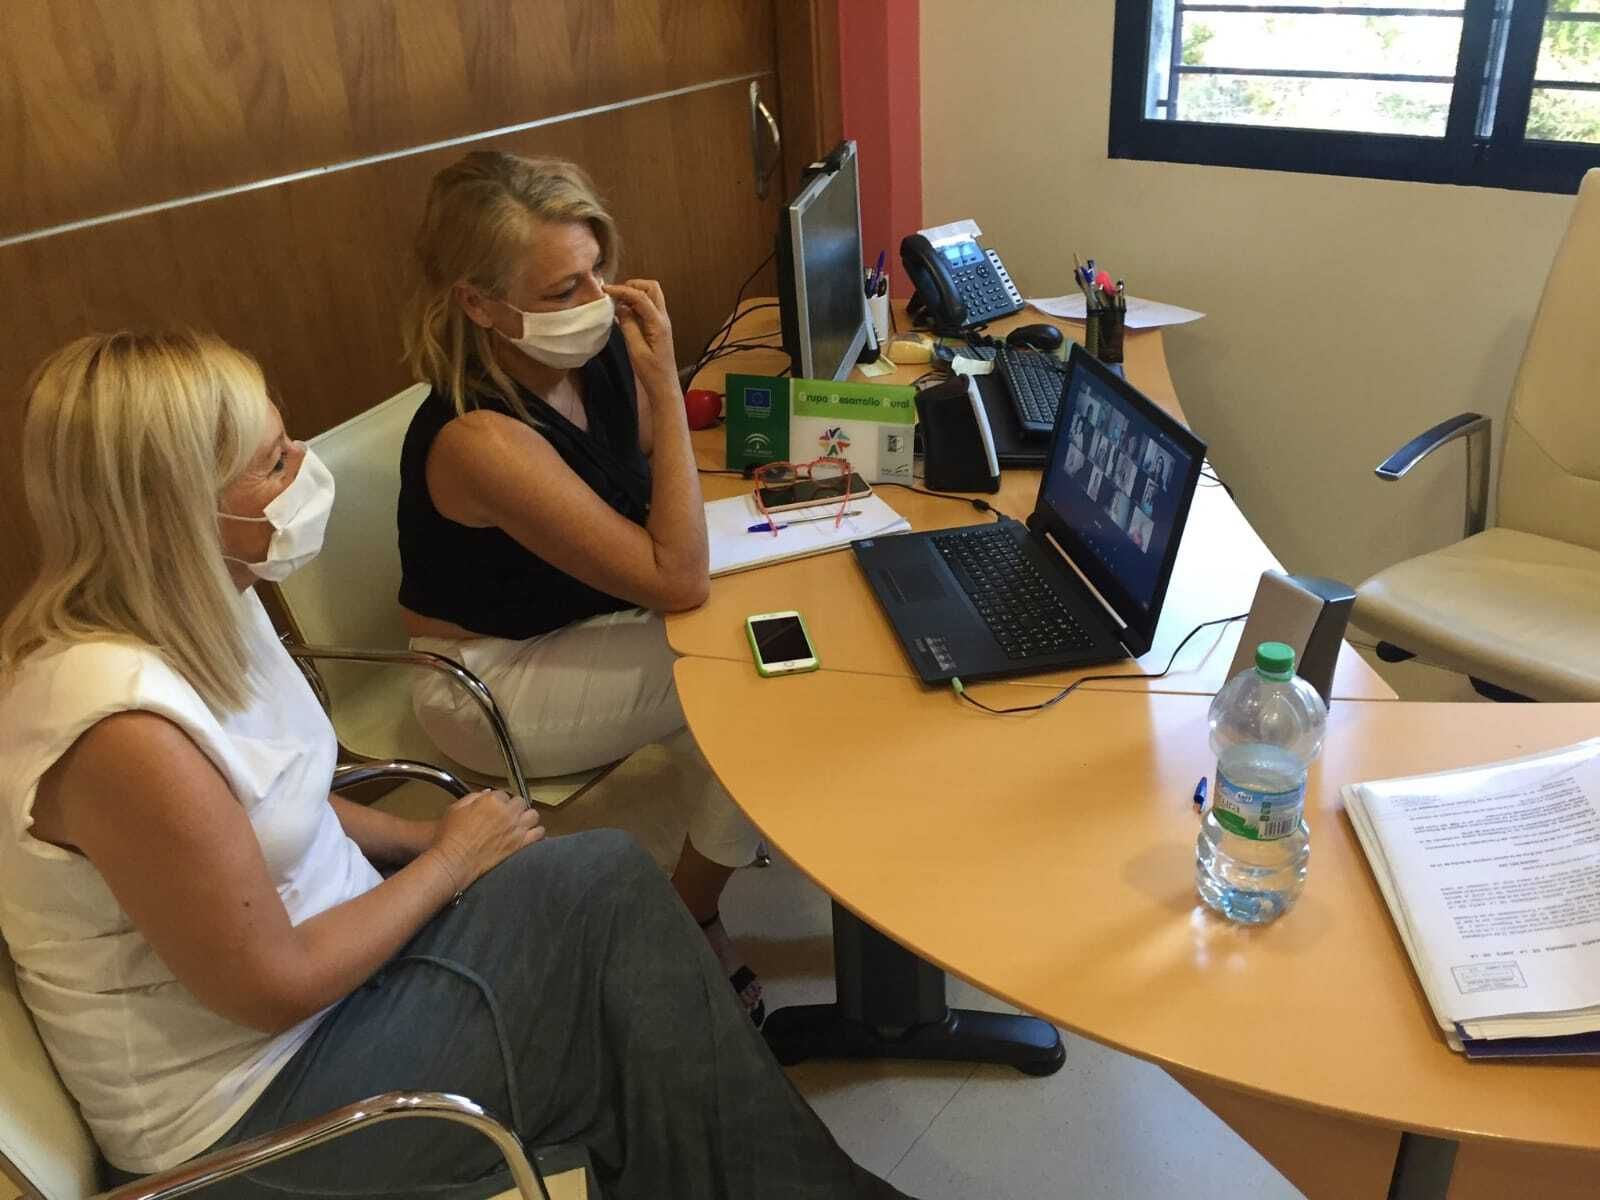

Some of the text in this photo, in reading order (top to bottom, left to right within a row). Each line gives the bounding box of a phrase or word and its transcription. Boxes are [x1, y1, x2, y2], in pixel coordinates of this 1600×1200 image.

[799, 392, 910, 408] Grupo Desarrollo Rural
